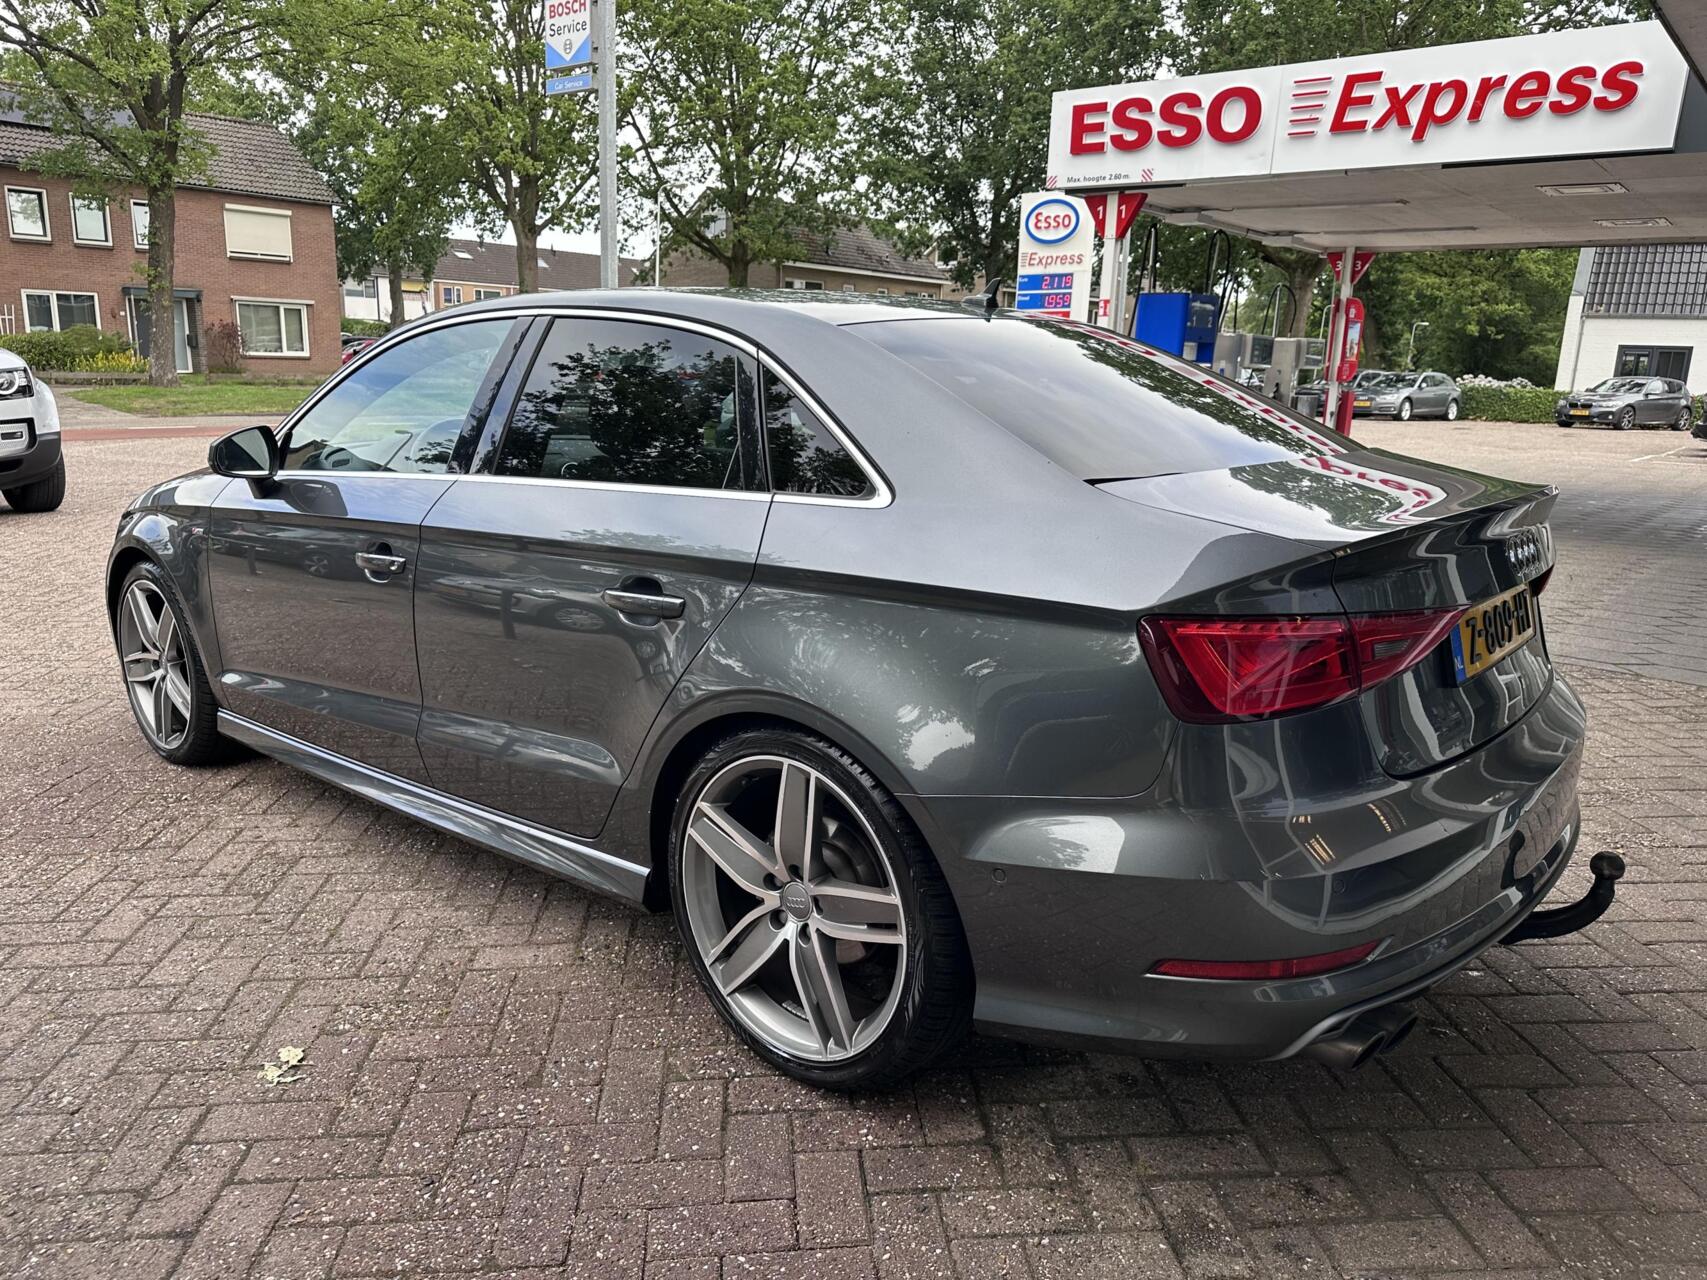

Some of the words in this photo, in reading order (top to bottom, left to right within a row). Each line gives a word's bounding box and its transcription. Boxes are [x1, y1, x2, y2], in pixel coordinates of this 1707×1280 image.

[549, 0, 587, 19] BOSCH
[549, 20, 587, 37] Service
[564, 80, 583, 89] Service
[1070, 86, 1263, 156] ESSO
[1328, 60, 1645, 143] Express
[1083, 175, 1107, 184] hoogte
[1097, 205, 1104, 219] 1
[1119, 204, 1126, 219] 1
[1027, 252, 1085, 269] Express
[1335, 261, 1343, 271] 3
[1354, 260, 1362, 271] 3
[1041, 275, 1073, 289] 2.119
